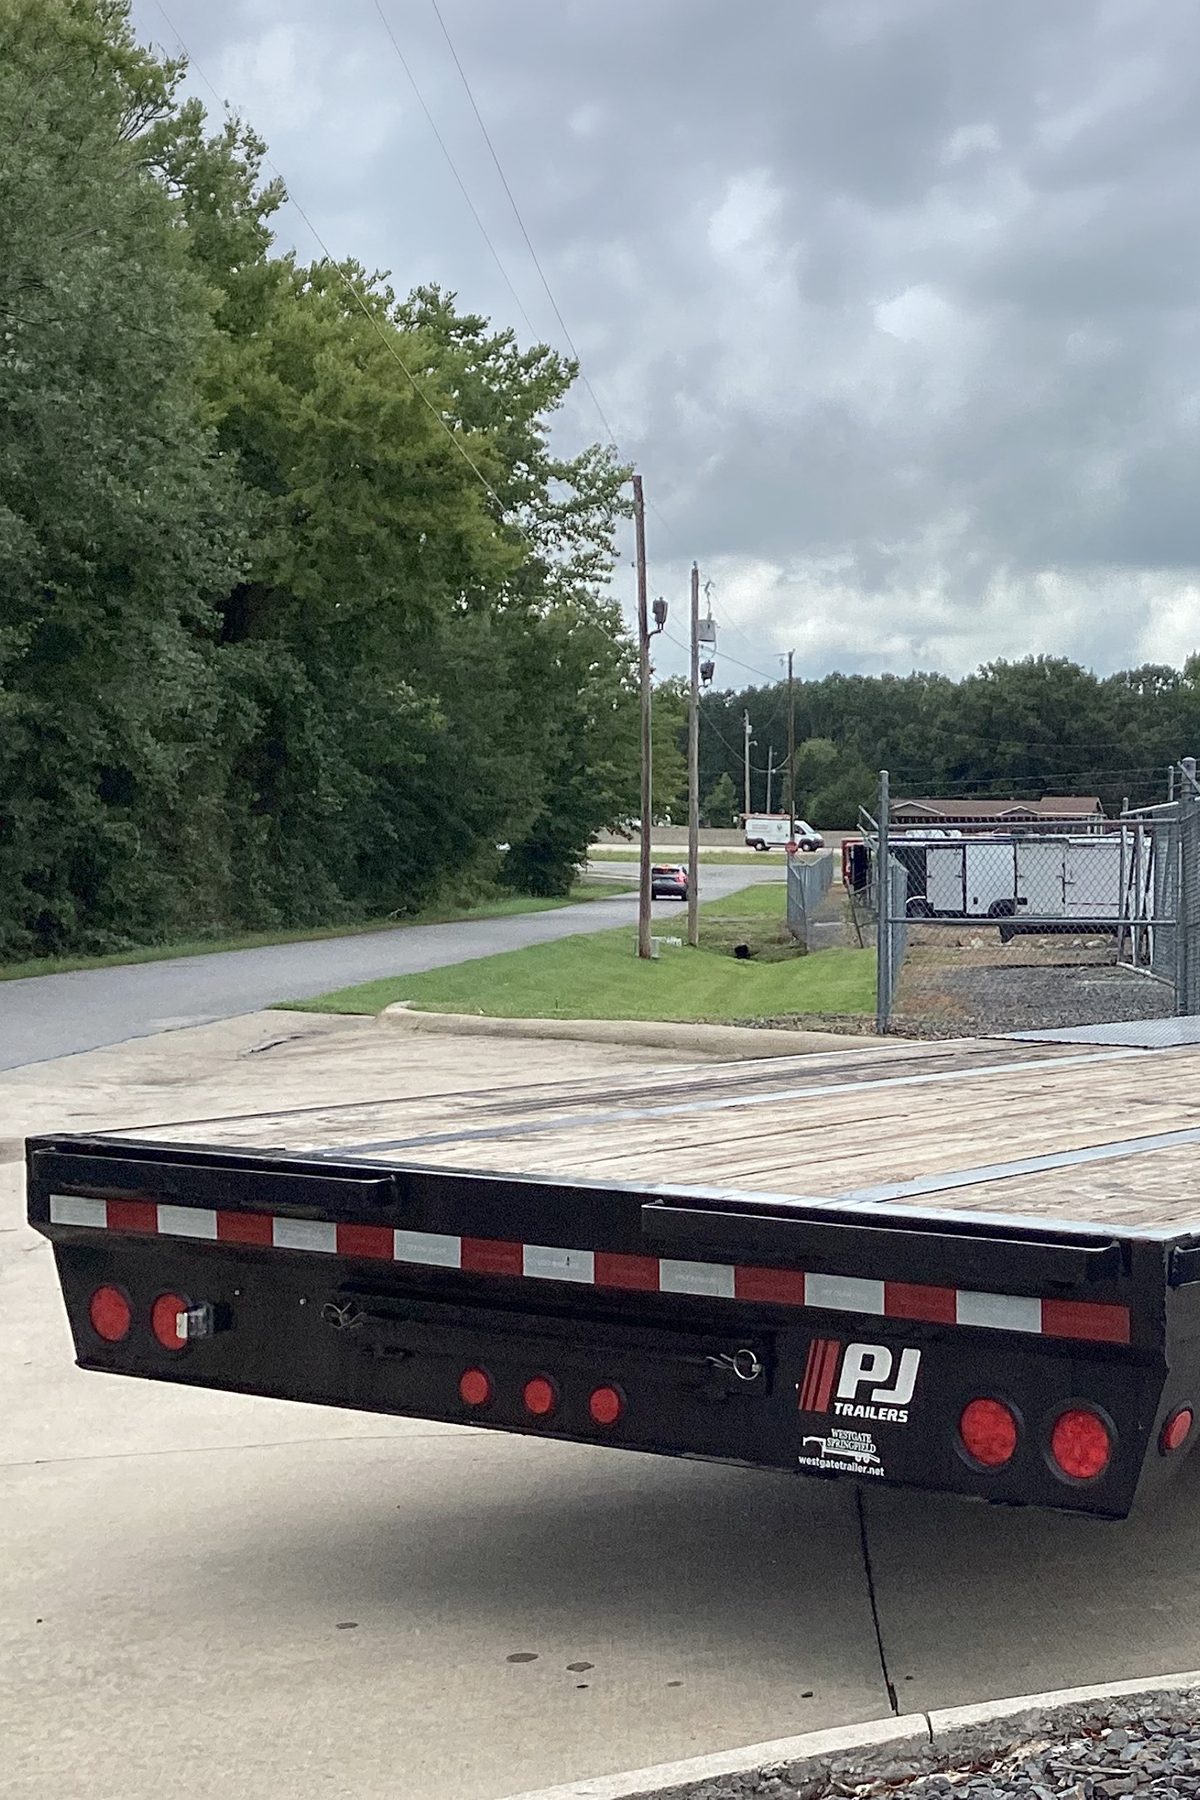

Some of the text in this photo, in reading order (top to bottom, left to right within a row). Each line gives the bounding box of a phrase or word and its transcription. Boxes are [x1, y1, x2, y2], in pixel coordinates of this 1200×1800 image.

[837, 1343, 921, 1405] PJ
[834, 1402, 909, 1423] TRAILERS
[827, 1437, 877, 1454] SPRINGFIELD
[831, 1428, 872, 1443] WESTGATE
[798, 1455, 885, 1477] westgatetrailer.net
